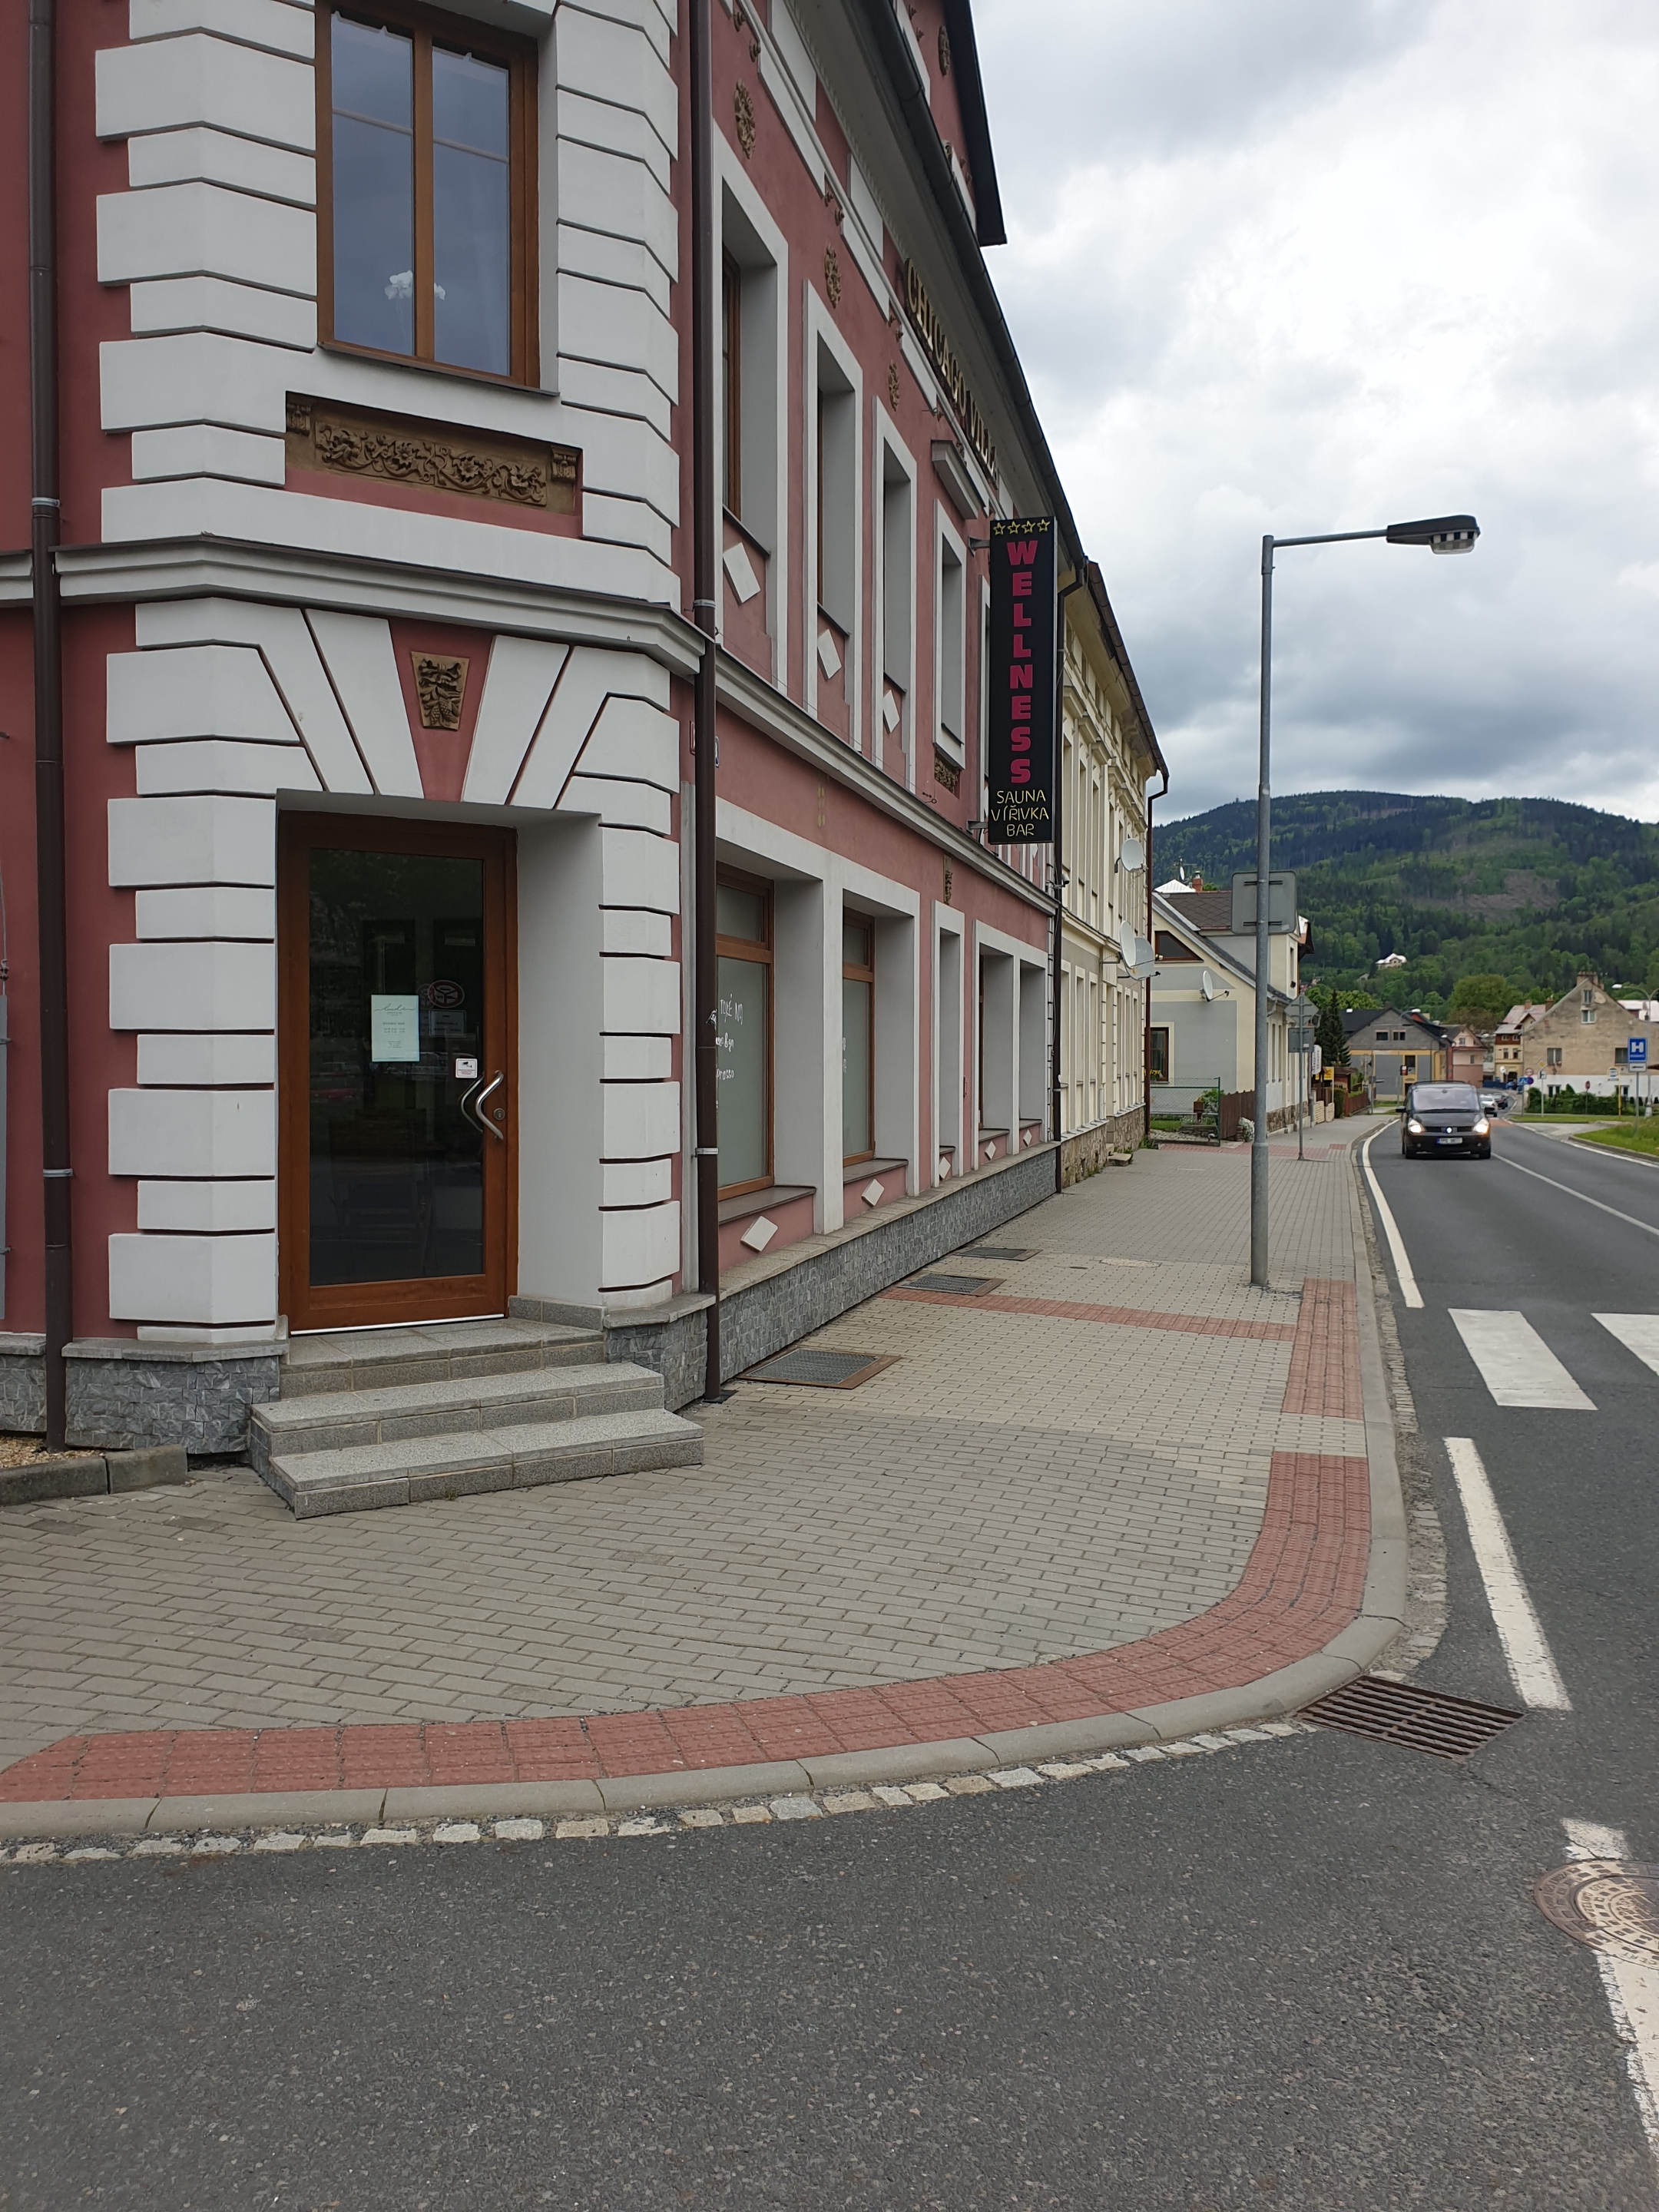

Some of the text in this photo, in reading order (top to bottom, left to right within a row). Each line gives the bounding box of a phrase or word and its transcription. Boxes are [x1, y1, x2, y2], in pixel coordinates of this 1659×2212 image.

[906, 257, 967, 417] CHICAGO
[1006, 540, 1038, 784] WELLNESS
[996, 789, 1046, 804] SAUNA
[991, 804, 1049, 822] VÍŘIVKA
[1006, 823, 1035, 837] BAR
[1631, 1041, 1644, 1053] H
